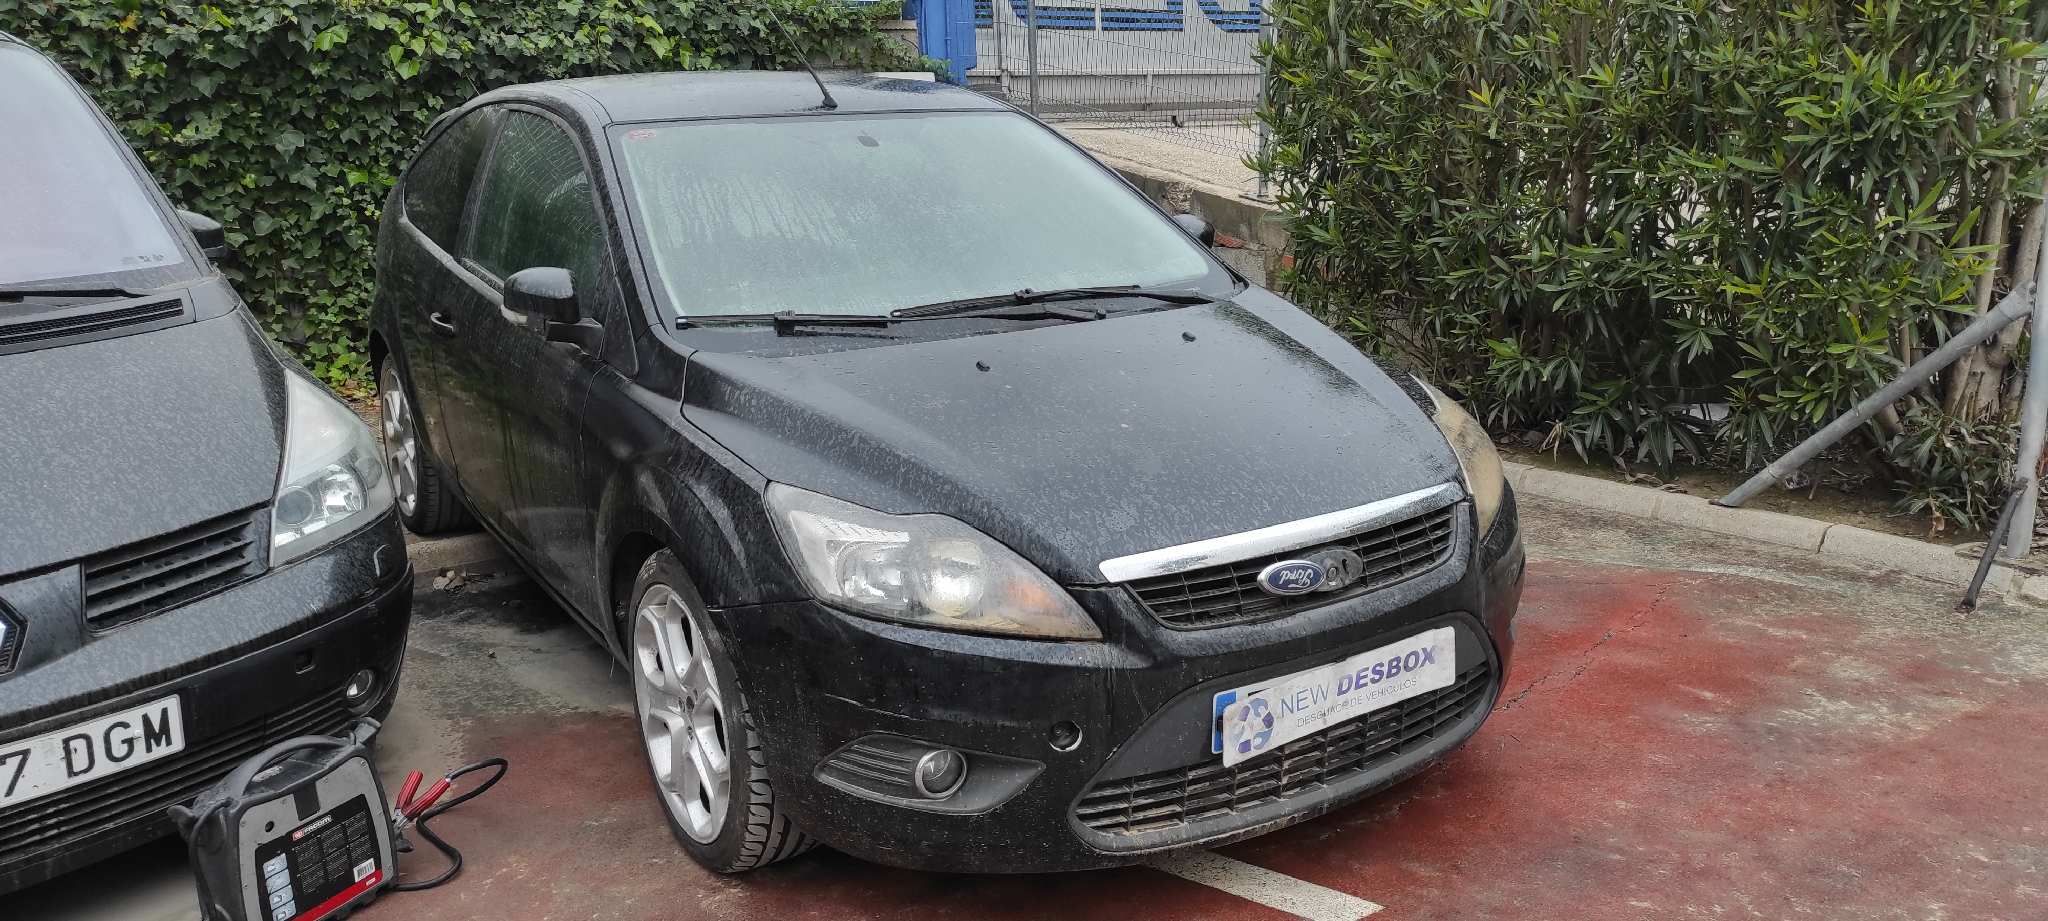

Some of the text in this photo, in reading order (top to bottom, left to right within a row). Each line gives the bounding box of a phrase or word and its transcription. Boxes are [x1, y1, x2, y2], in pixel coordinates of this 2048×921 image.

[1279, 568, 1314, 588] Ford
[1281, 645, 1436, 718] NEW DESBOX
[0, 706, 173, 797] 7 DGM
